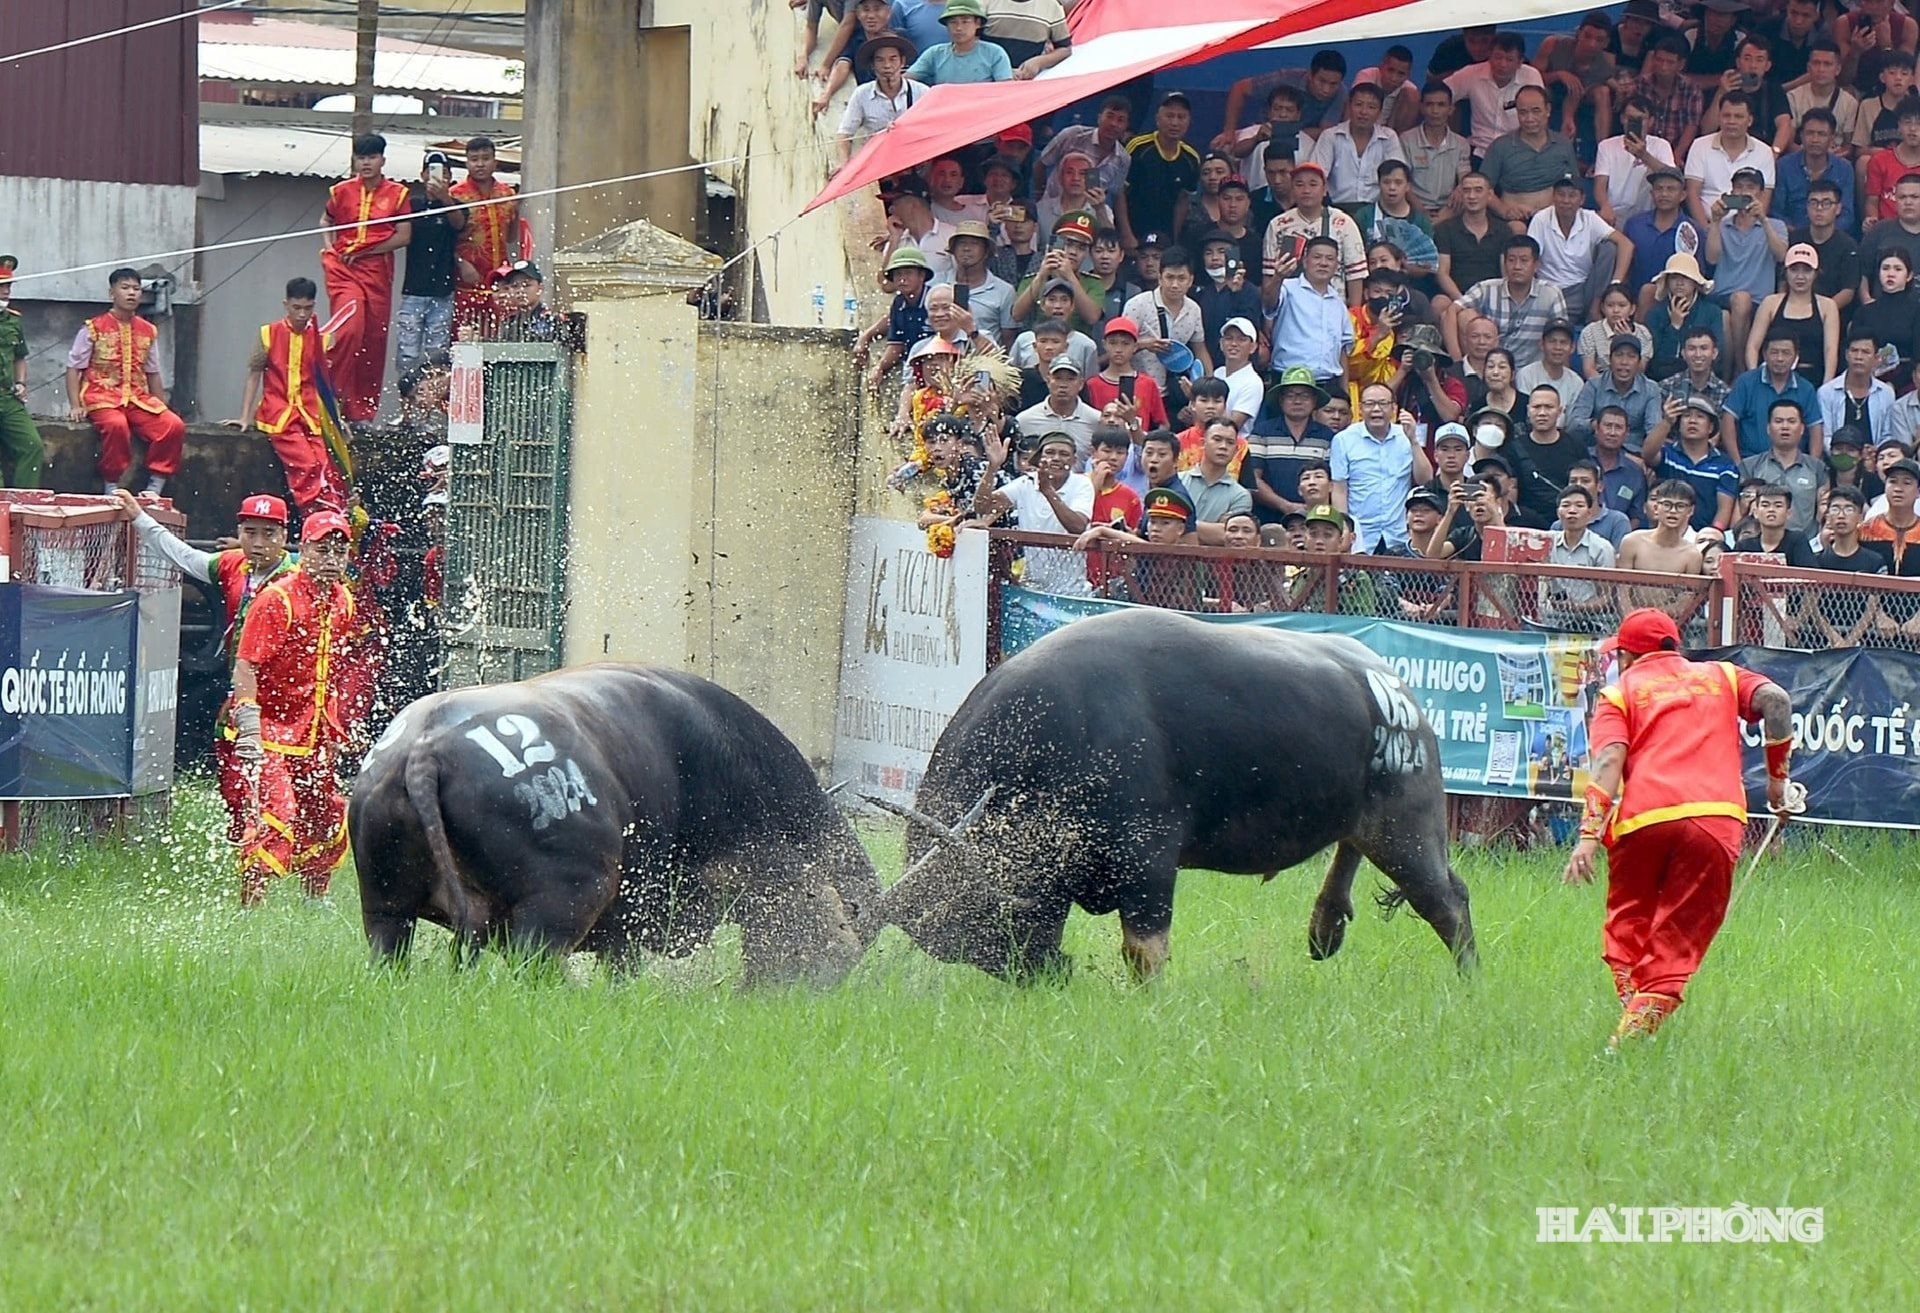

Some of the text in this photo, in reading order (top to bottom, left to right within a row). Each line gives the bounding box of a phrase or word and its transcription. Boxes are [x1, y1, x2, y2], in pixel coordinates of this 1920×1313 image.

[2, 648, 47, 714] QUỐC
[48, 650, 67, 714] TẾ
[1426, 659, 1486, 693] HUGO
[465, 714, 556, 778] 12
[1450, 702, 1488, 743] TRẺ
[1871, 702, 1910, 755] TẾ
